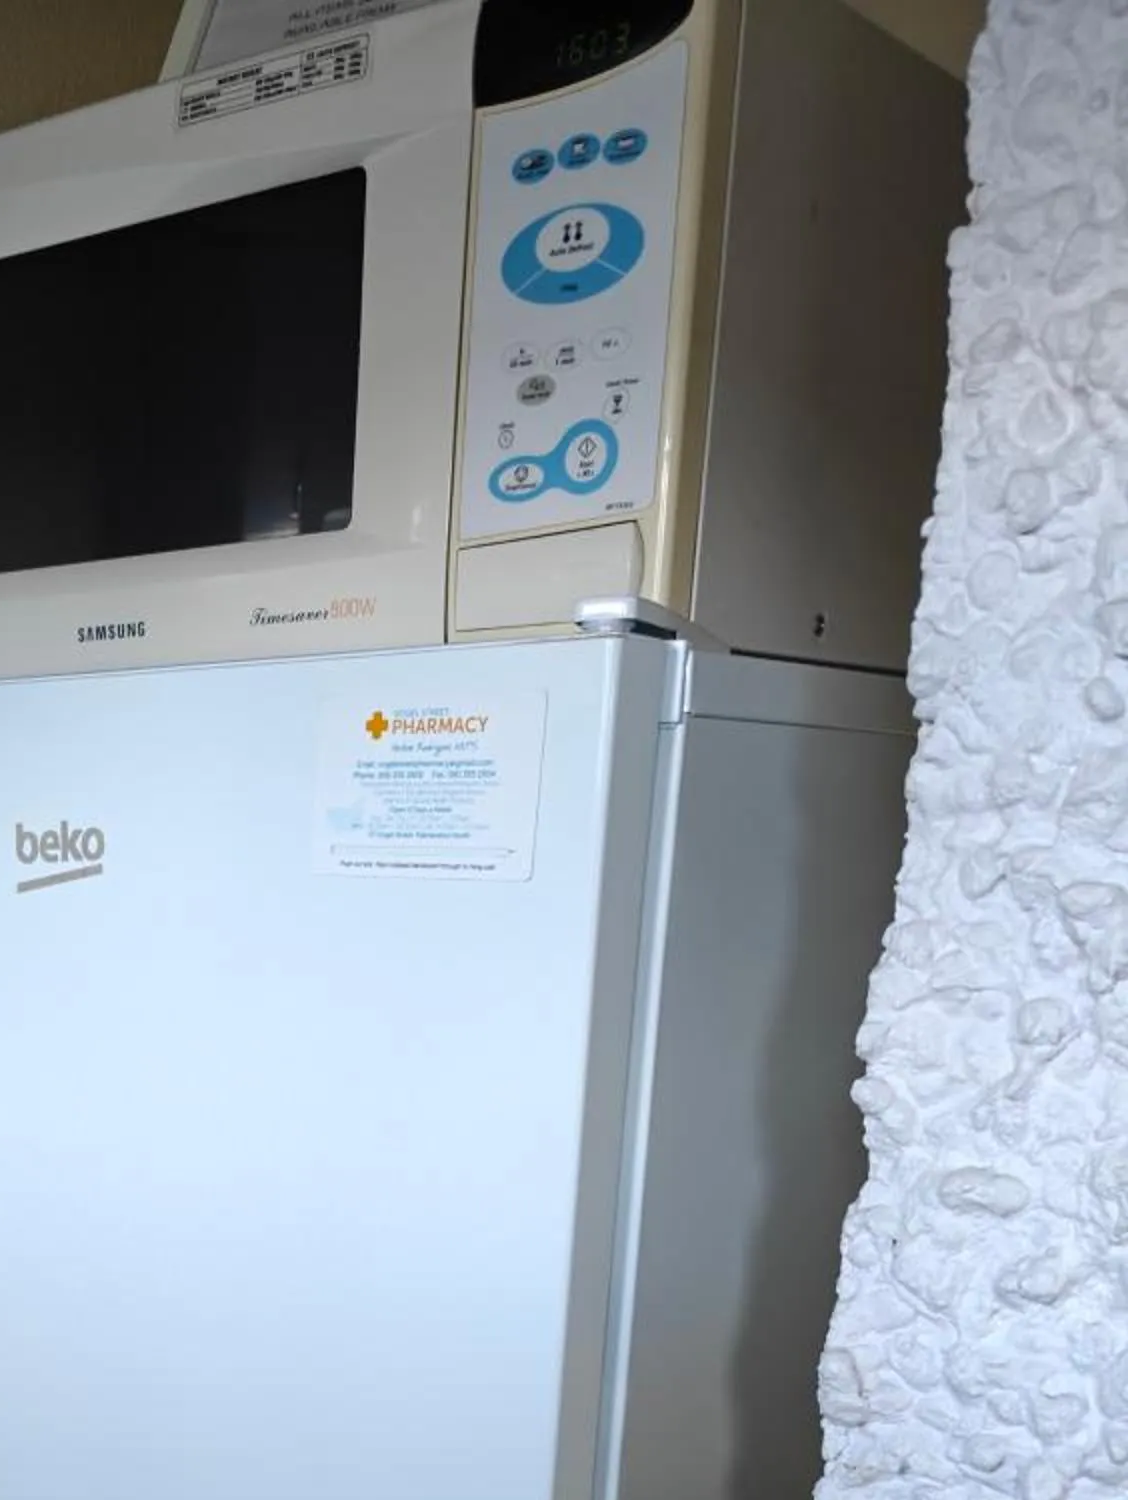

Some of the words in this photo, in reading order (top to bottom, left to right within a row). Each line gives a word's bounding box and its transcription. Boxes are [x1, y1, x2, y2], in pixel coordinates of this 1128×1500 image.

[77, 621, 146, 643] SAMSUNG
[392, 716, 489, 735] PHARMACY
[15, 820, 105, 865] beko
